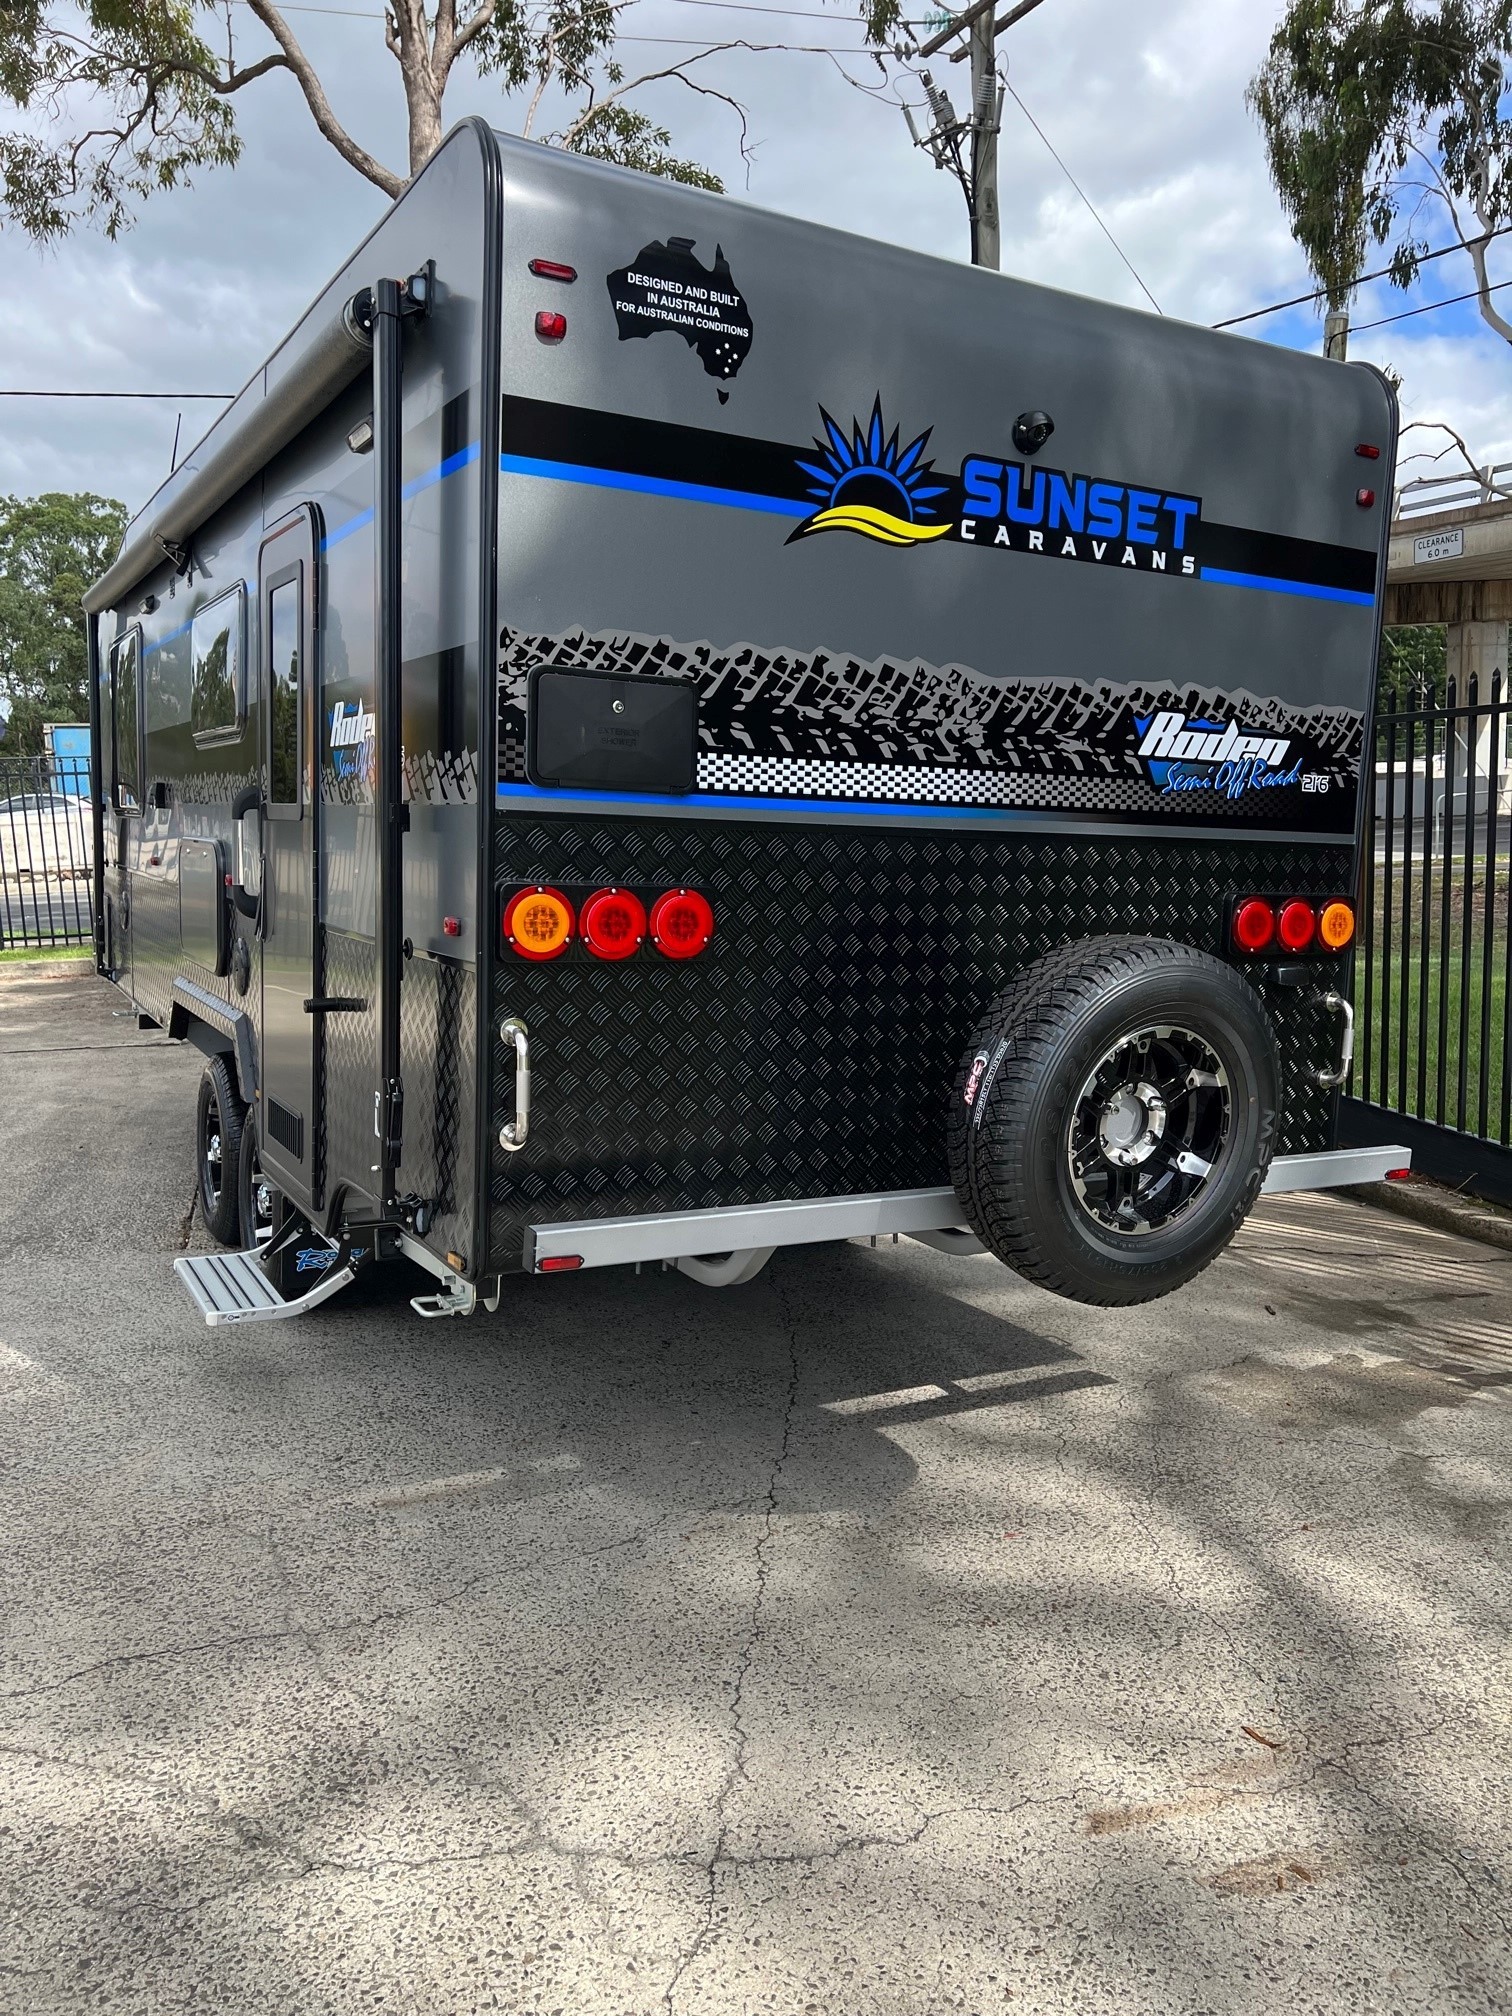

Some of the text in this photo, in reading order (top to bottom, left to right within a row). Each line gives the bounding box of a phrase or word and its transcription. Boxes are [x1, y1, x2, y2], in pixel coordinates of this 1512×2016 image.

[627, 272, 739, 307] DESIGNED AND BUILT
[647, 292, 720, 318] IN AUSTRALIA
[616, 301, 749, 337] FOR AUSTRALIAN CONDITIONS
[962, 459, 1198, 549] SUNSET
[960, 519, 1195, 574] CARAVANS
[1418, 533, 1459, 550] CLEARANCE
[1427, 548, 1440, 558] 6.0
[1137, 711, 1291, 766] Rodeo
[1161, 757, 1303, 799] Semi Off Road
